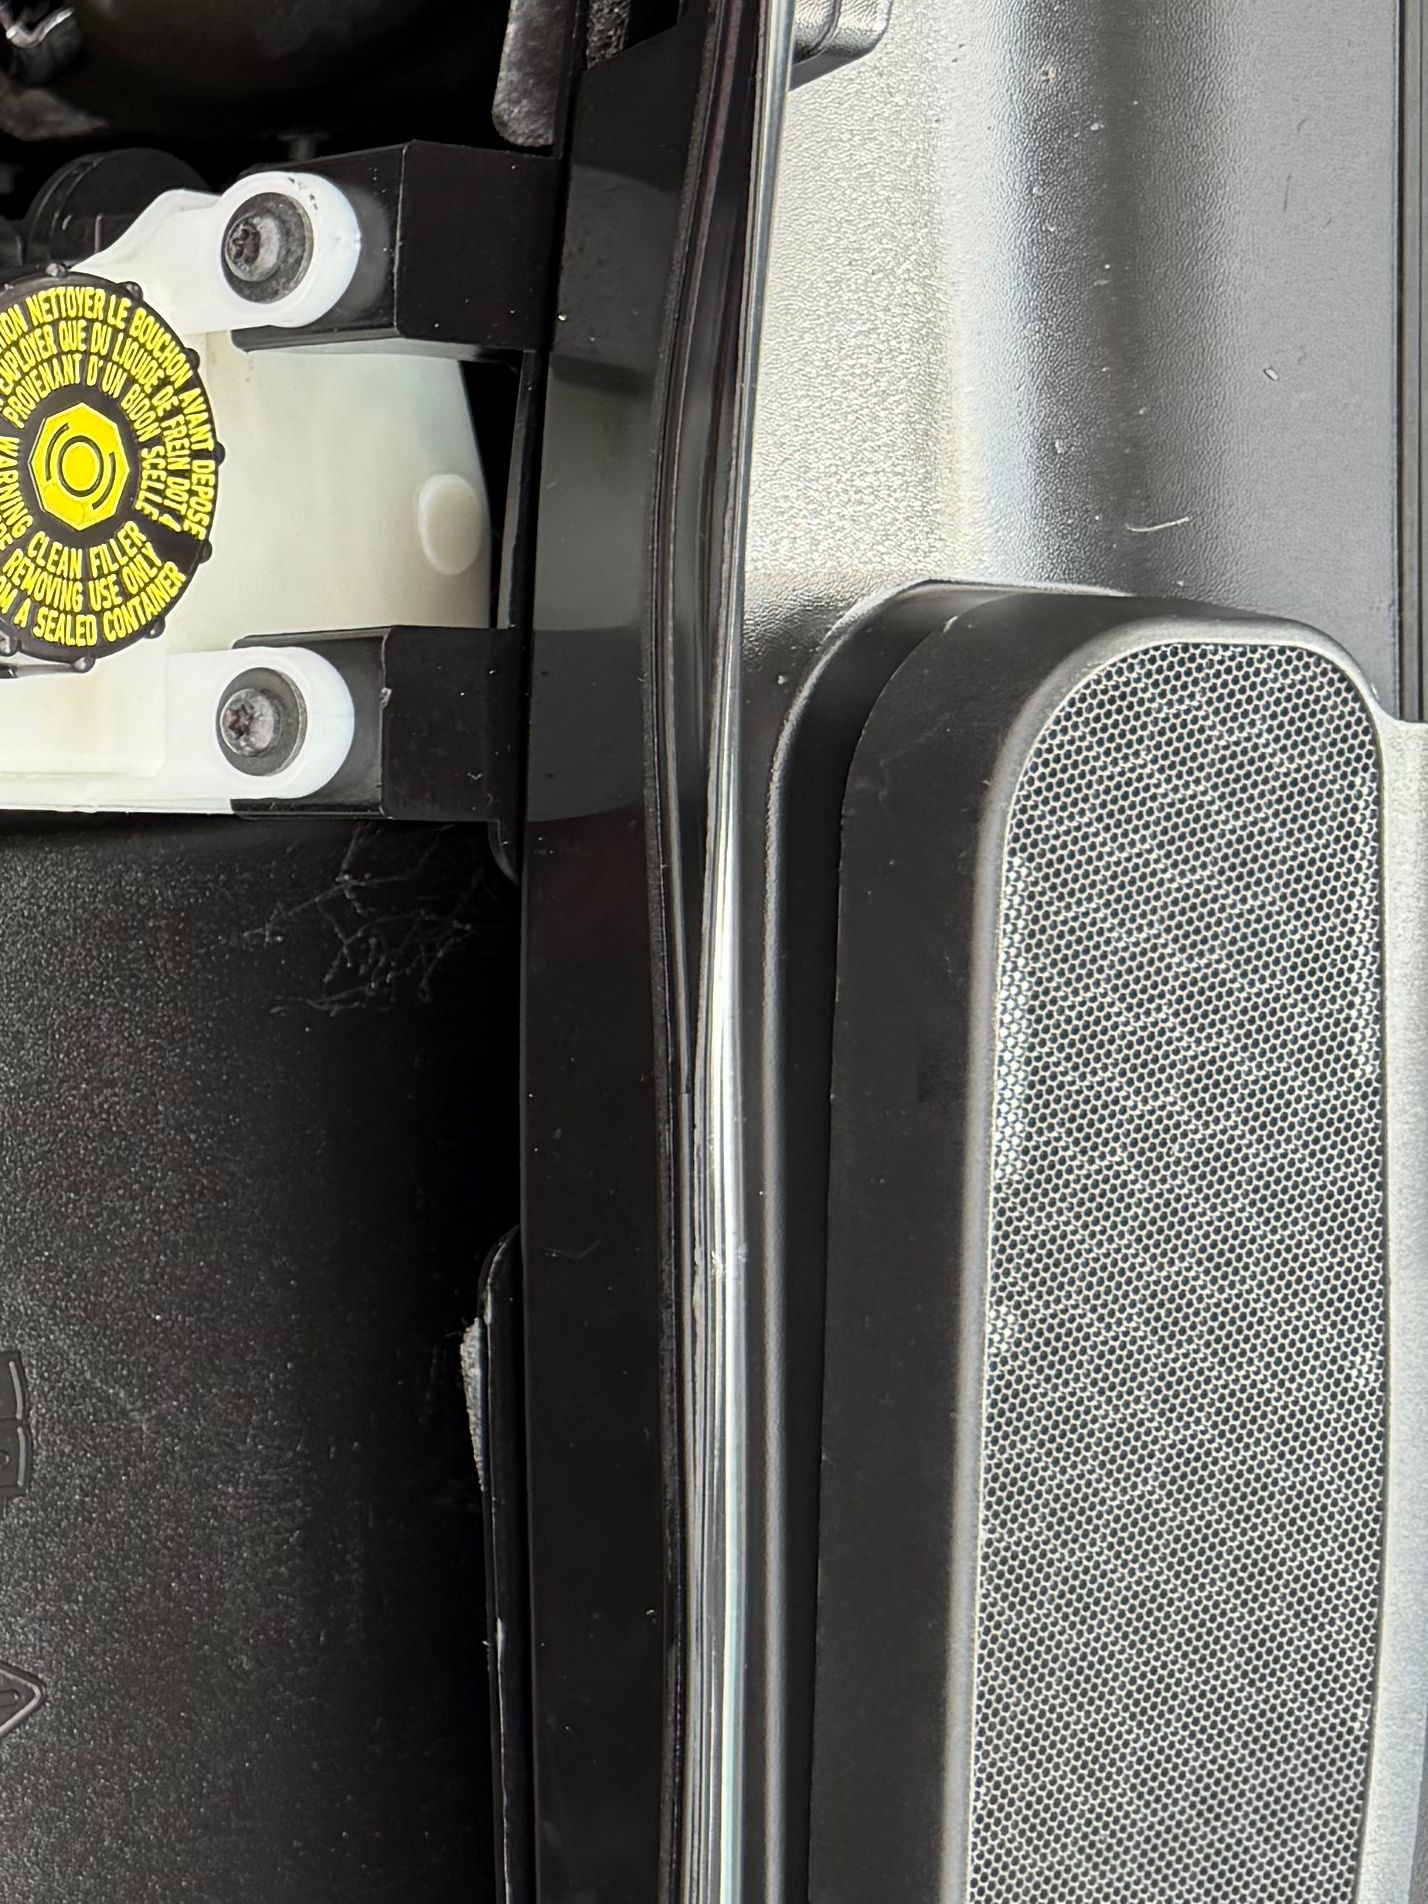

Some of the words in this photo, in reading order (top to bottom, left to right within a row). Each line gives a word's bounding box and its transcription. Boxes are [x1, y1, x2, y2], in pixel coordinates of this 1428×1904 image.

[26, 287, 105, 320] NETTOYER
[108, 294, 131, 325] LE
[58, 321, 86, 351] QUE
[90, 324, 109, 354] DU
[113, 333, 164, 393] LIQUIDE
[130, 309, 192, 388] BOUCHON
[4, 355, 81, 428] PROVENANT
[121, 387, 161, 441] BIDON
[156, 389, 179, 417] DE
[163, 418, 190, 470] FREIN
[179, 388, 214, 451] AVANT
[135, 446, 166, 519] SCELLE
[165, 468, 187, 510] DOT
[182, 459, 216, 539] DEPOSE
[160, 509, 182, 532] 4
[28, 531, 83, 576] CLEAN
[89, 521, 147, 576] FILLER
[3, 549, 83, 612] REMOVING
[88, 579, 121, 612] USE
[121, 542, 163, 596] ONLY
[13, 603, 29, 628] A
[33, 606, 97, 647] SEALED
[103, 561, 186, 642] CONTAINER
